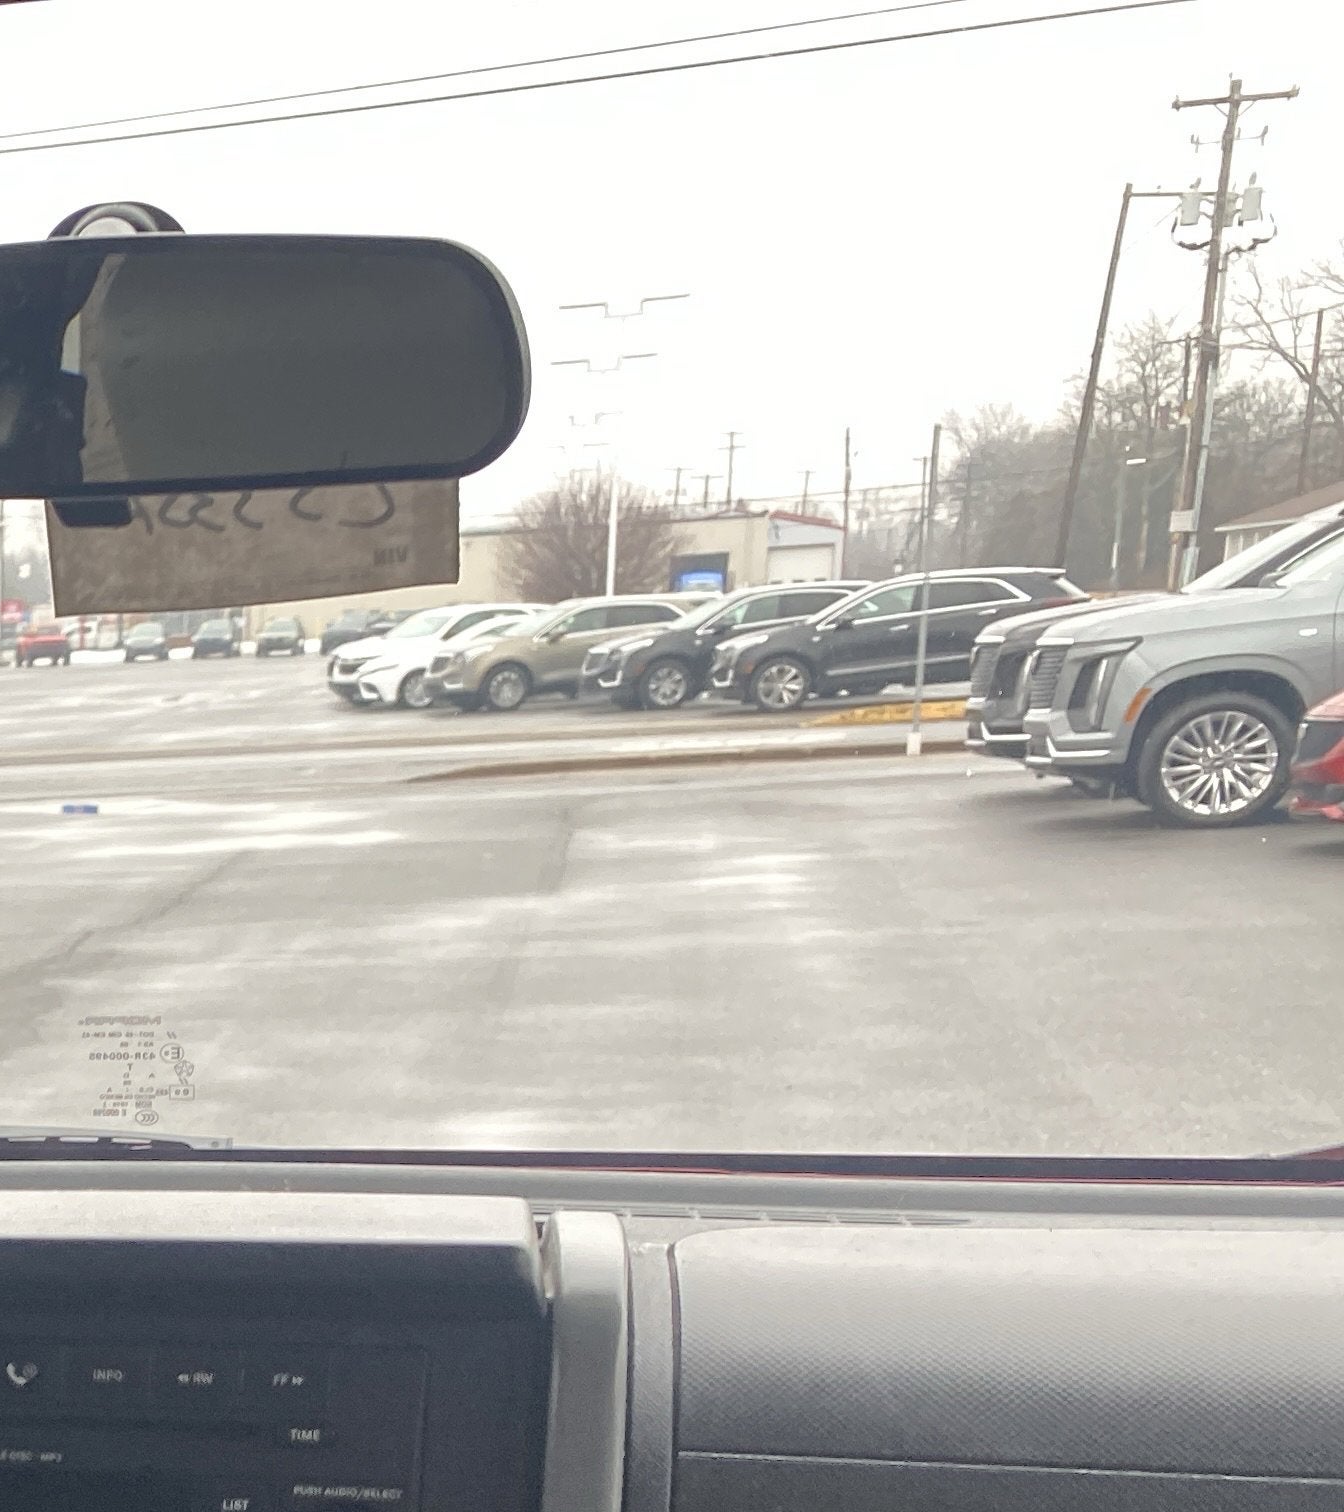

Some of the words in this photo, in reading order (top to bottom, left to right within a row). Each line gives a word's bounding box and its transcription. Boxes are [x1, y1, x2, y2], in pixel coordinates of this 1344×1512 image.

[92, 1368, 124, 1383] INFO
[192, 1371, 214, 1385] RW
[272, 1373, 289, 1386] FF
[289, 1427, 320, 1442] TIME
[293, 1484, 322, 1497] PUSH
[324, 1485, 403, 1500] AUDIO/SELECT
[222, 1498, 250, 1512] LIST
